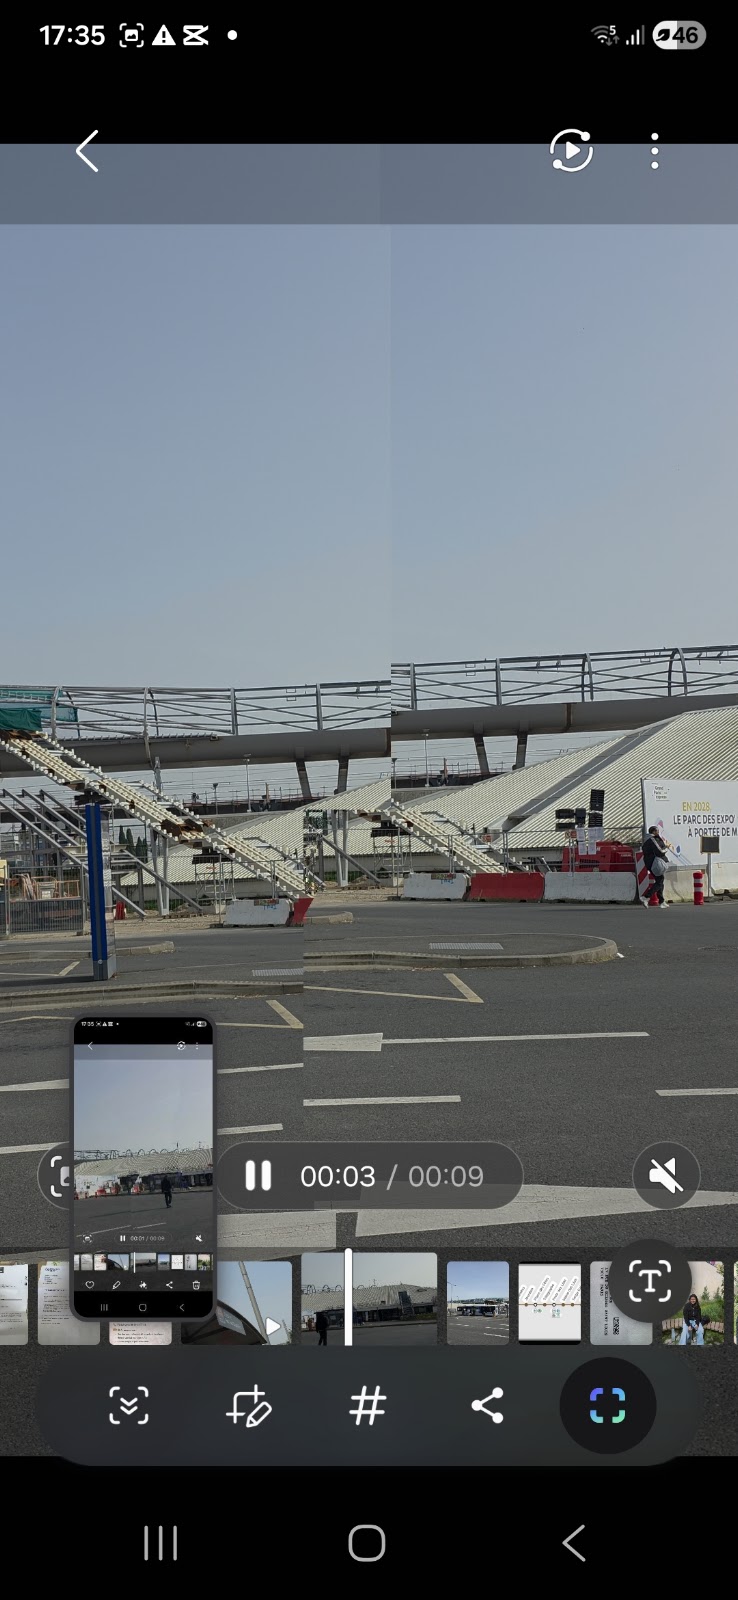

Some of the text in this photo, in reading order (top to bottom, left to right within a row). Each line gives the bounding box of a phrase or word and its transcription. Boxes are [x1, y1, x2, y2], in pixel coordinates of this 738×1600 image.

[682, 802, 692, 812] EN
[673, 815, 681, 825] LE
[683, 815, 701, 825] PARC
[703, 815, 716, 824] DES
[722, 827, 730, 837] DE
